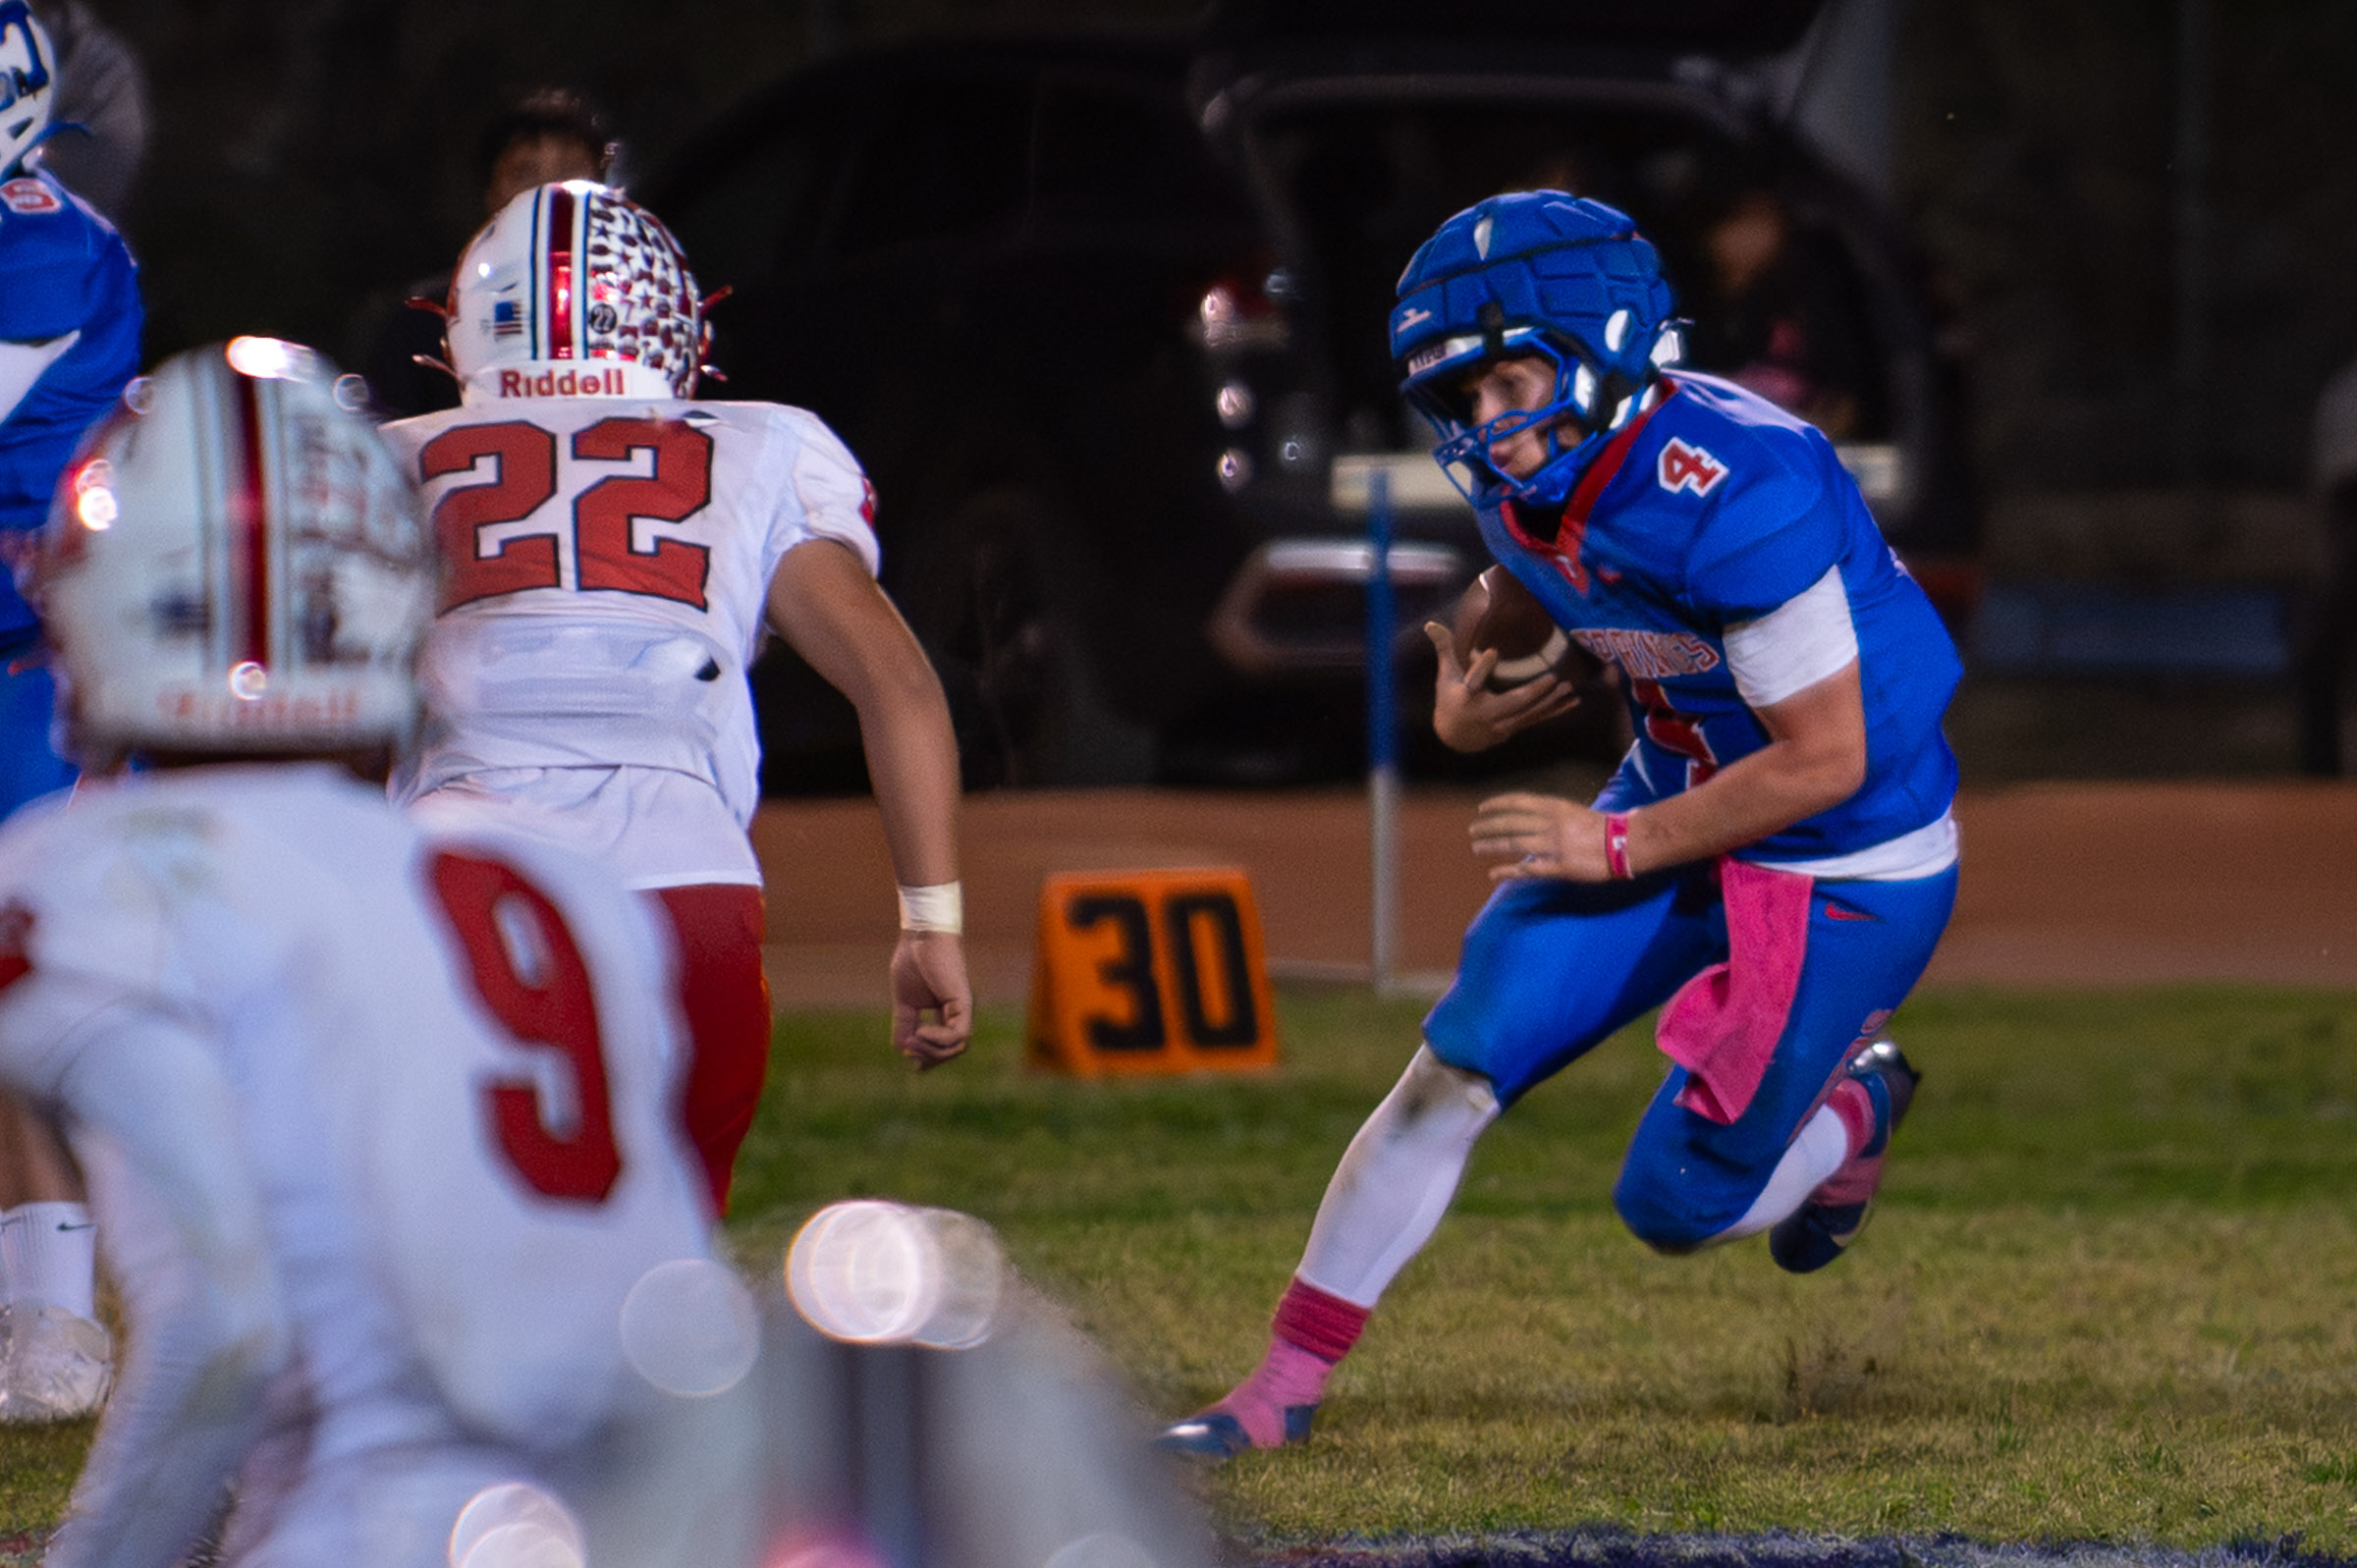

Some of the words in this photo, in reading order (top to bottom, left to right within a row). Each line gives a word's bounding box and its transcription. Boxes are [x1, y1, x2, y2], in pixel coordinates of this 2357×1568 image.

[500, 368, 626, 398] Riddell
[419, 415, 714, 618] 22
[1657, 436, 1729, 499] 4
[419, 848, 628, 1208] 9
[1064, 893, 1260, 1052] 30
